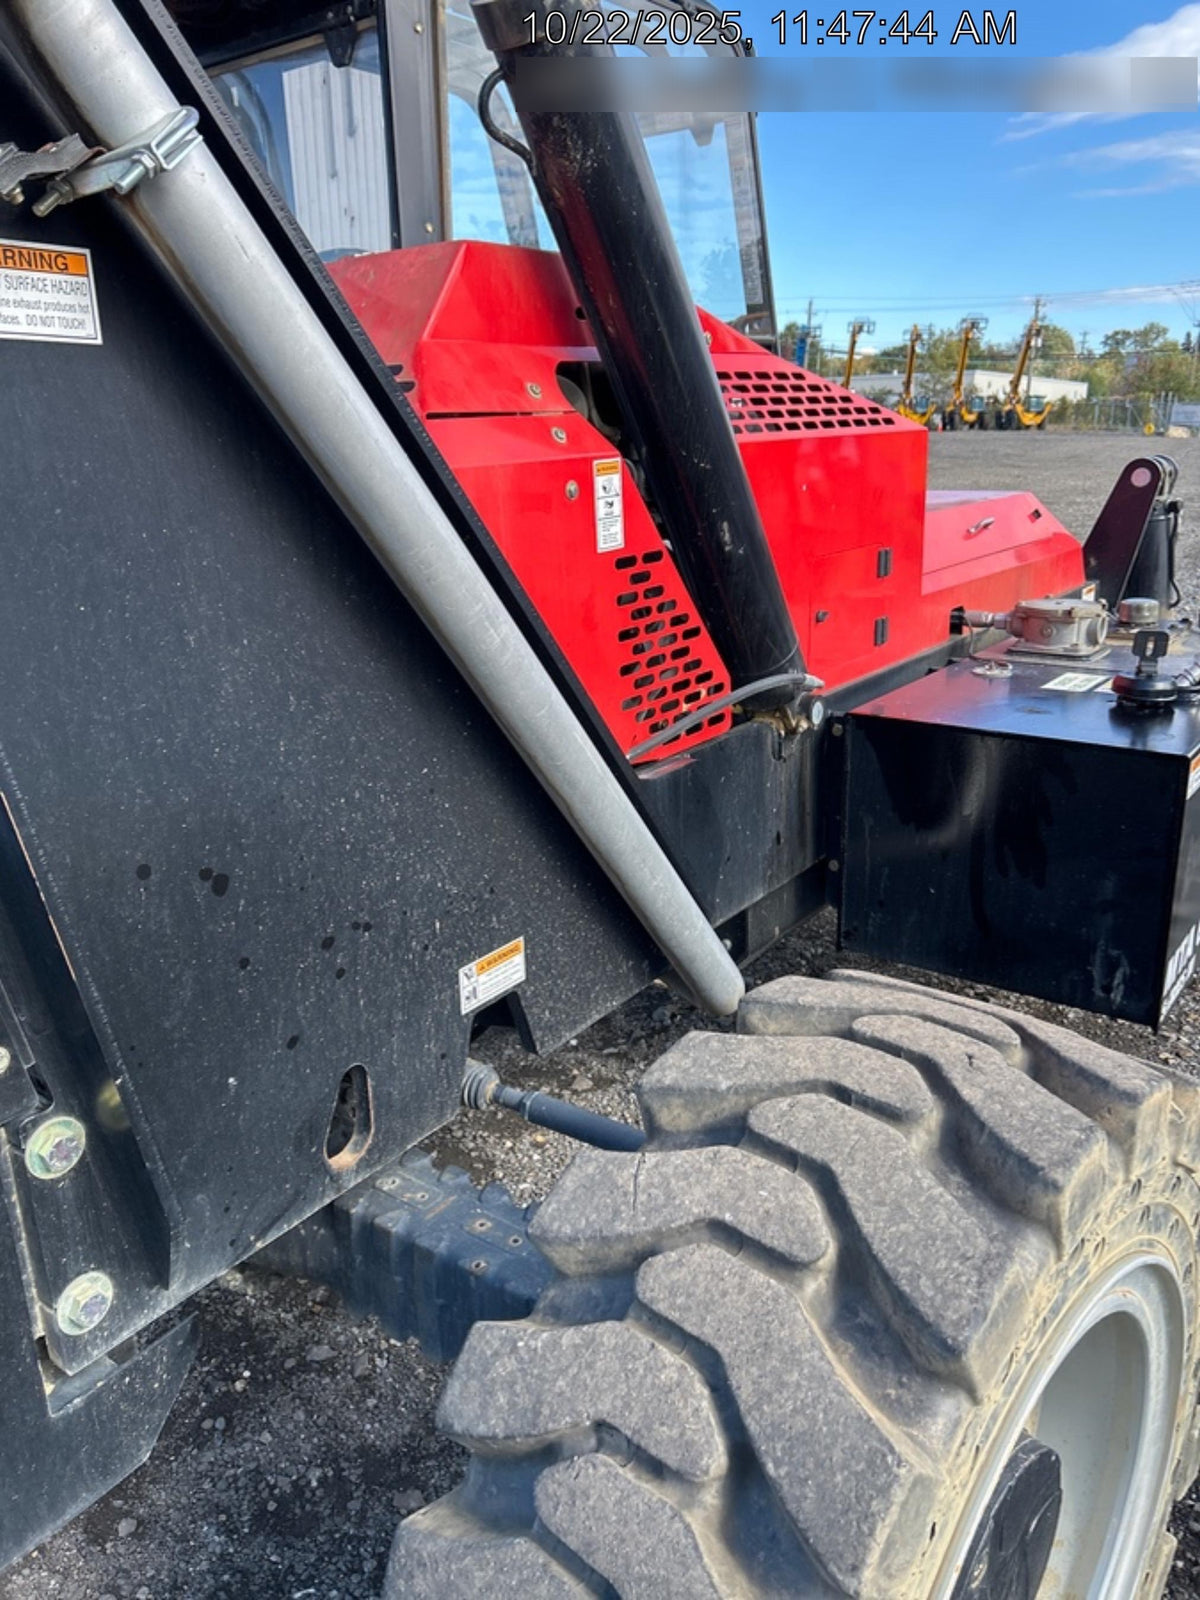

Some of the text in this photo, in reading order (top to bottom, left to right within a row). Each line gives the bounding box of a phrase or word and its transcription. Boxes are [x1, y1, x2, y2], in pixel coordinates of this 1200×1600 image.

[0, 247, 69, 271] RNING
[4, 274, 88, 297] SURFACE HAZARD
